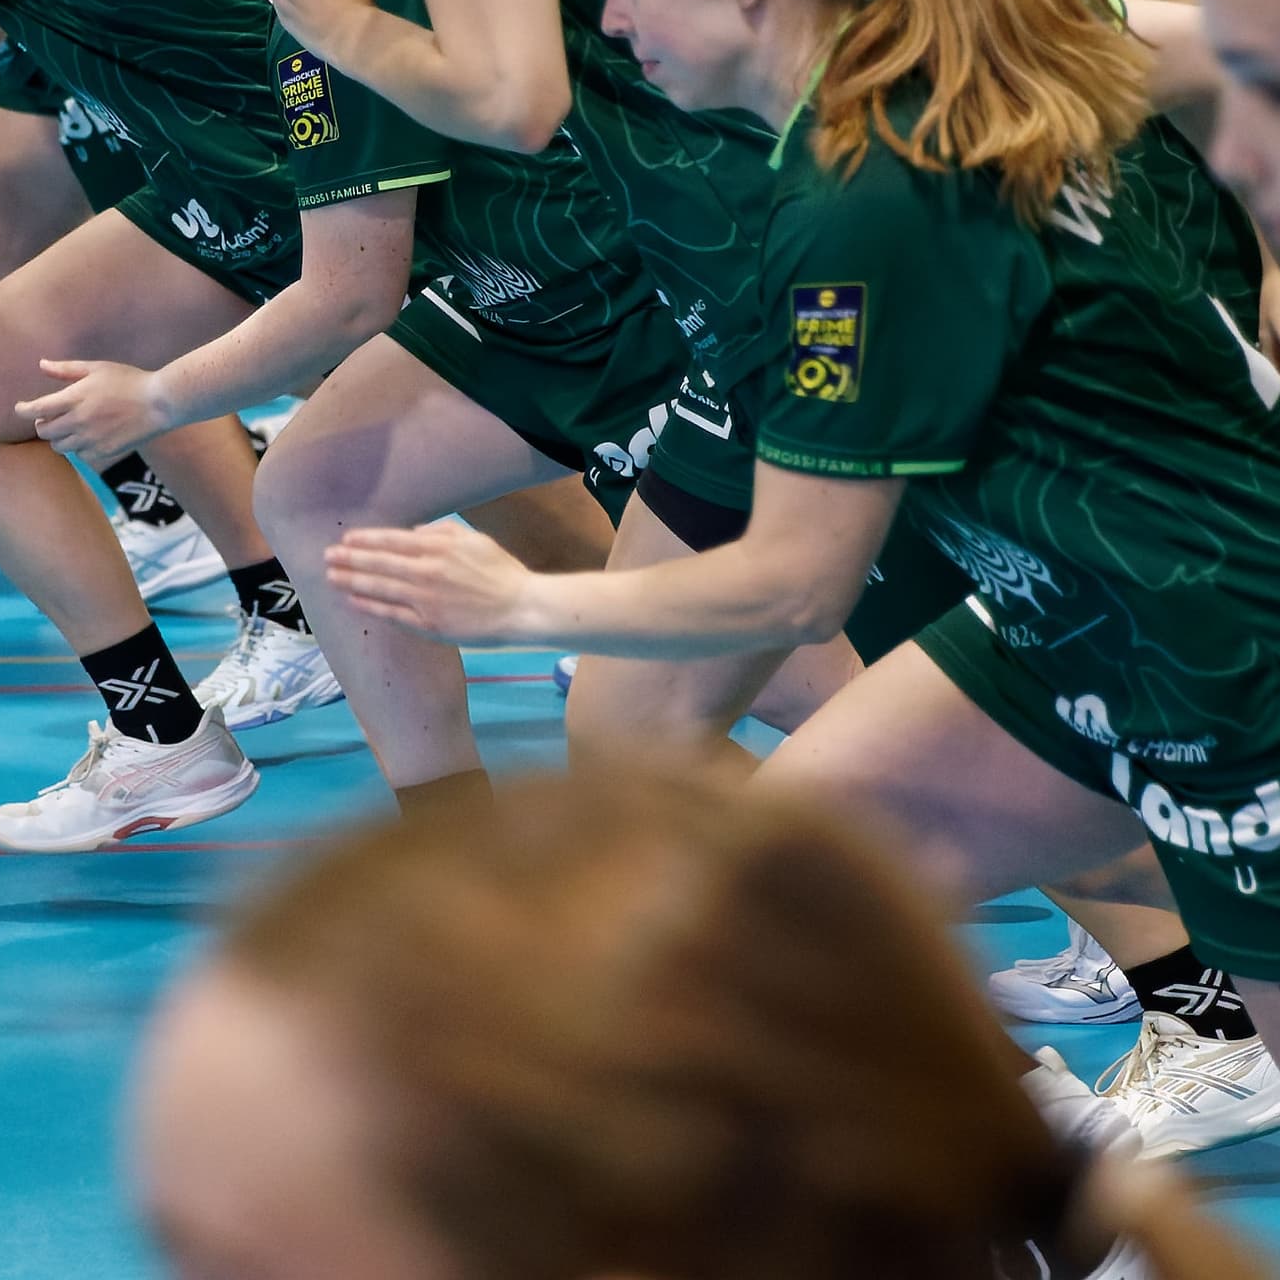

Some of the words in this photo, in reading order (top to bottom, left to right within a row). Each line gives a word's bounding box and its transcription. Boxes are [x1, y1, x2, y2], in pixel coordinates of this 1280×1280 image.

[282, 75, 323, 98] PRIME
[285, 87, 324, 110] LEAGUE
[331, 183, 373, 201] FAMILIE
